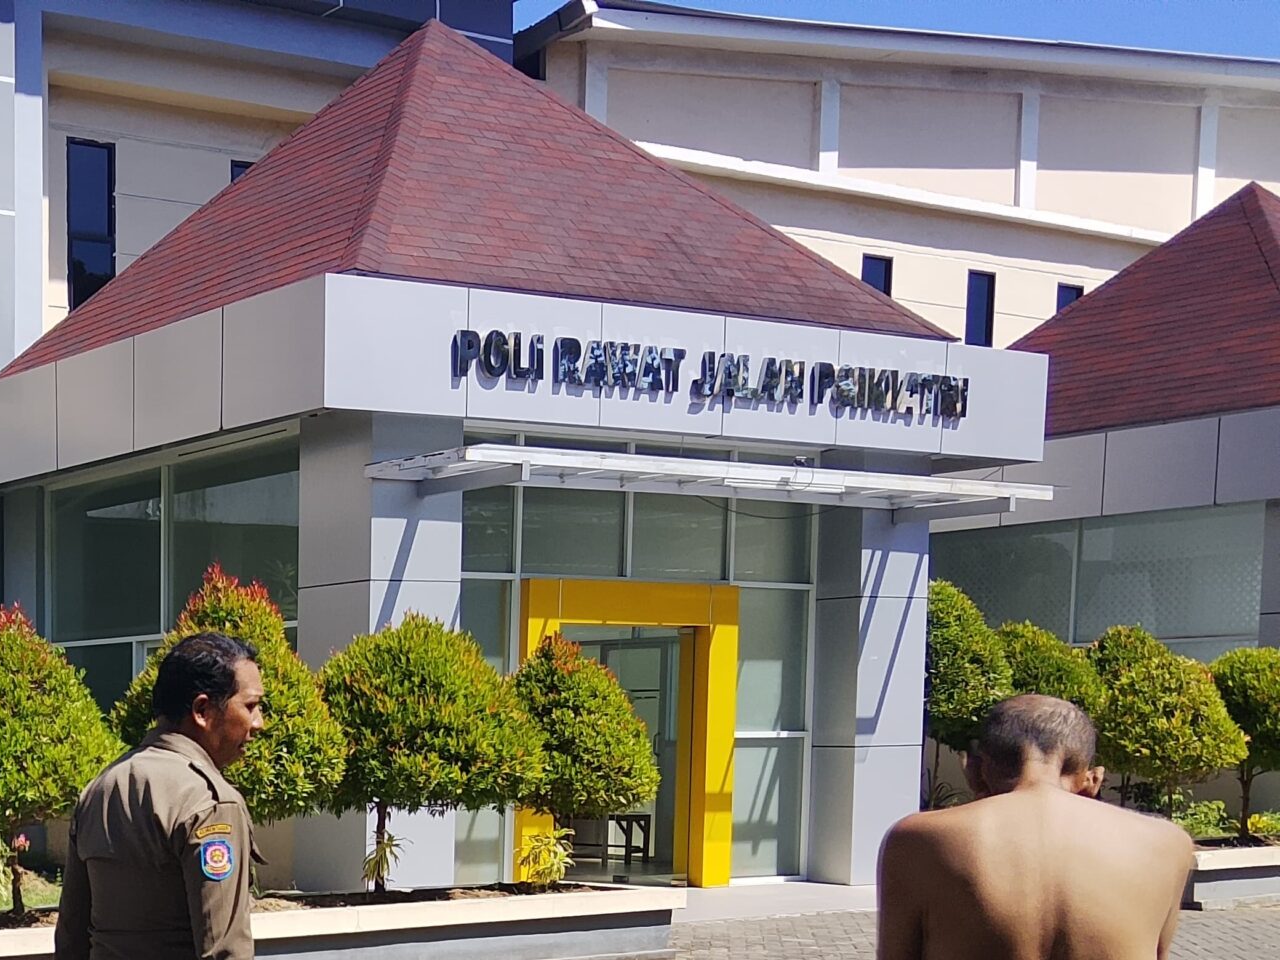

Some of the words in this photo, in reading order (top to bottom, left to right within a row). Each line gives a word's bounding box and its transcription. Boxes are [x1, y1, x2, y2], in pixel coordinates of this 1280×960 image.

[451, 330, 544, 380] POLI
[552, 337, 686, 392] RAWAT
[688, 351, 806, 403] JALAN
[809, 361, 970, 418] PSIKIATRI
